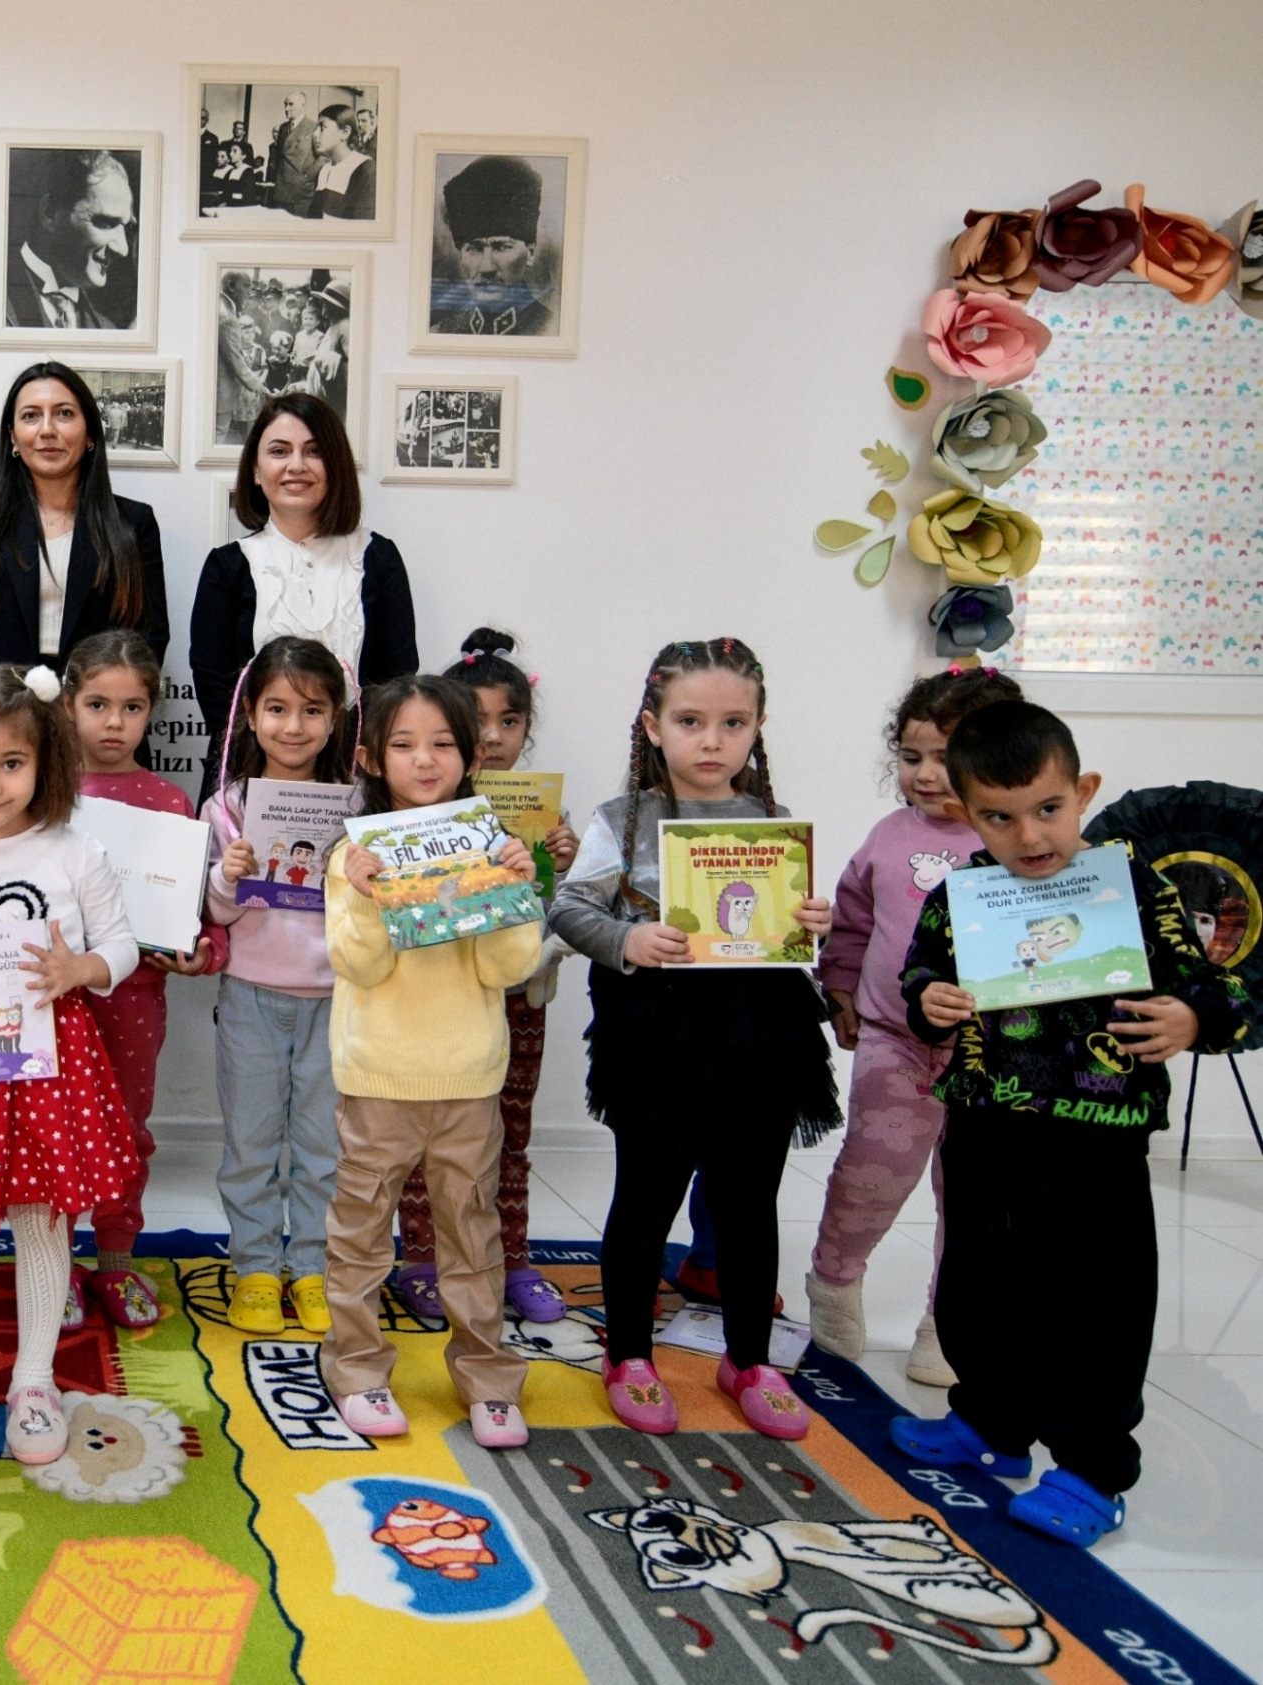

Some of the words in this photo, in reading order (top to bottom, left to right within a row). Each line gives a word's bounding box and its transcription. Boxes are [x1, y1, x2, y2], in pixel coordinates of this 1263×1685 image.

[164, 676, 197, 700] ha
[490, 794, 517, 802] KÜFÜR
[513, 803, 544, 811] İNCİTME
[261, 813, 287, 821] BENİM
[312, 817, 329, 825] ÇOK
[268, 805, 292, 813] BANA
[294, 807, 322, 815] LAKAP
[324, 809, 353, 817] TAKMA
[436, 826, 452, 835] OLAN
[394, 842, 421, 862] FİL
[423, 835, 472, 859] NİLPO
[689, 844, 785, 857] DİKENLERİNDEN
[693, 858, 741, 868] UTANAN
[745, 856, 778, 867] KİRPİ
[976, 888, 1017, 900] AKRAN
[1020, 874, 1099, 895] ZORBALIĞINA
[987, 900, 1012, 909] DUR
[1015, 885, 1091, 905] DİYEBİLİRSİN
[1053, 1098, 1149, 1127] BATMAN
[251, 1346, 349, 1440] HOME
[907, 1468, 989, 1508] Dog
